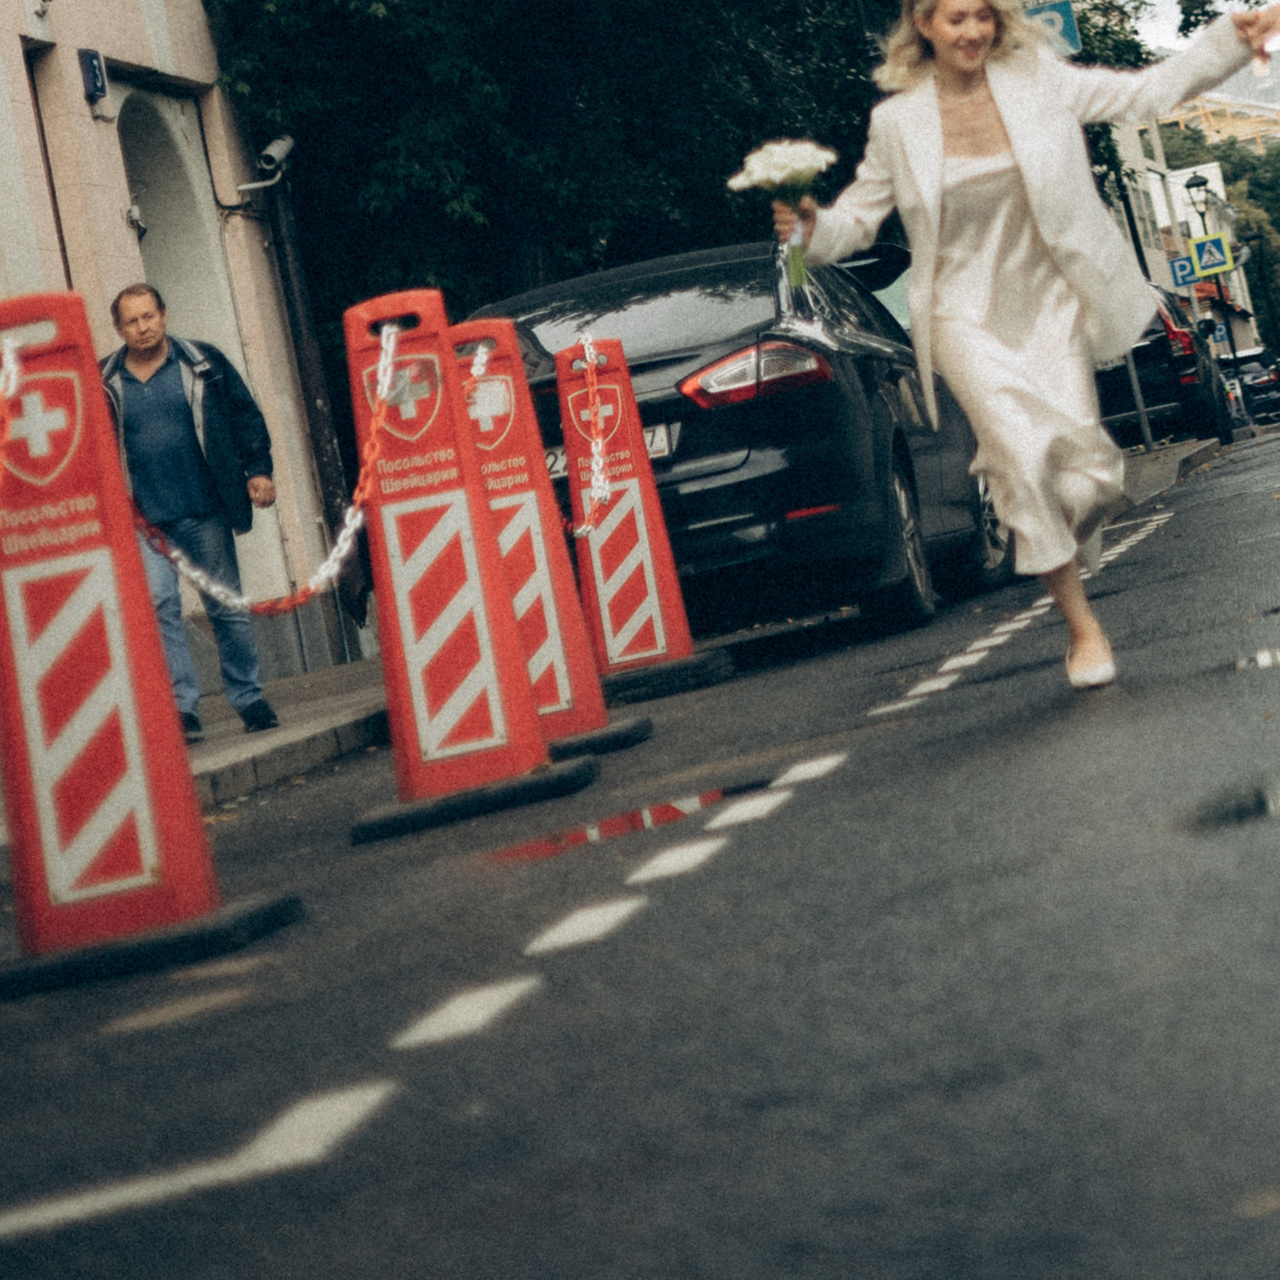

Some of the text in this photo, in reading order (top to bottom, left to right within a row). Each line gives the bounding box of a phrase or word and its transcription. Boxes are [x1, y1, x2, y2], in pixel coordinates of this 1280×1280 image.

[1174, 261, 1191, 284] P
[376, 448, 455, 475] Посольство
[380, 467, 458, 494] Швейцарии
